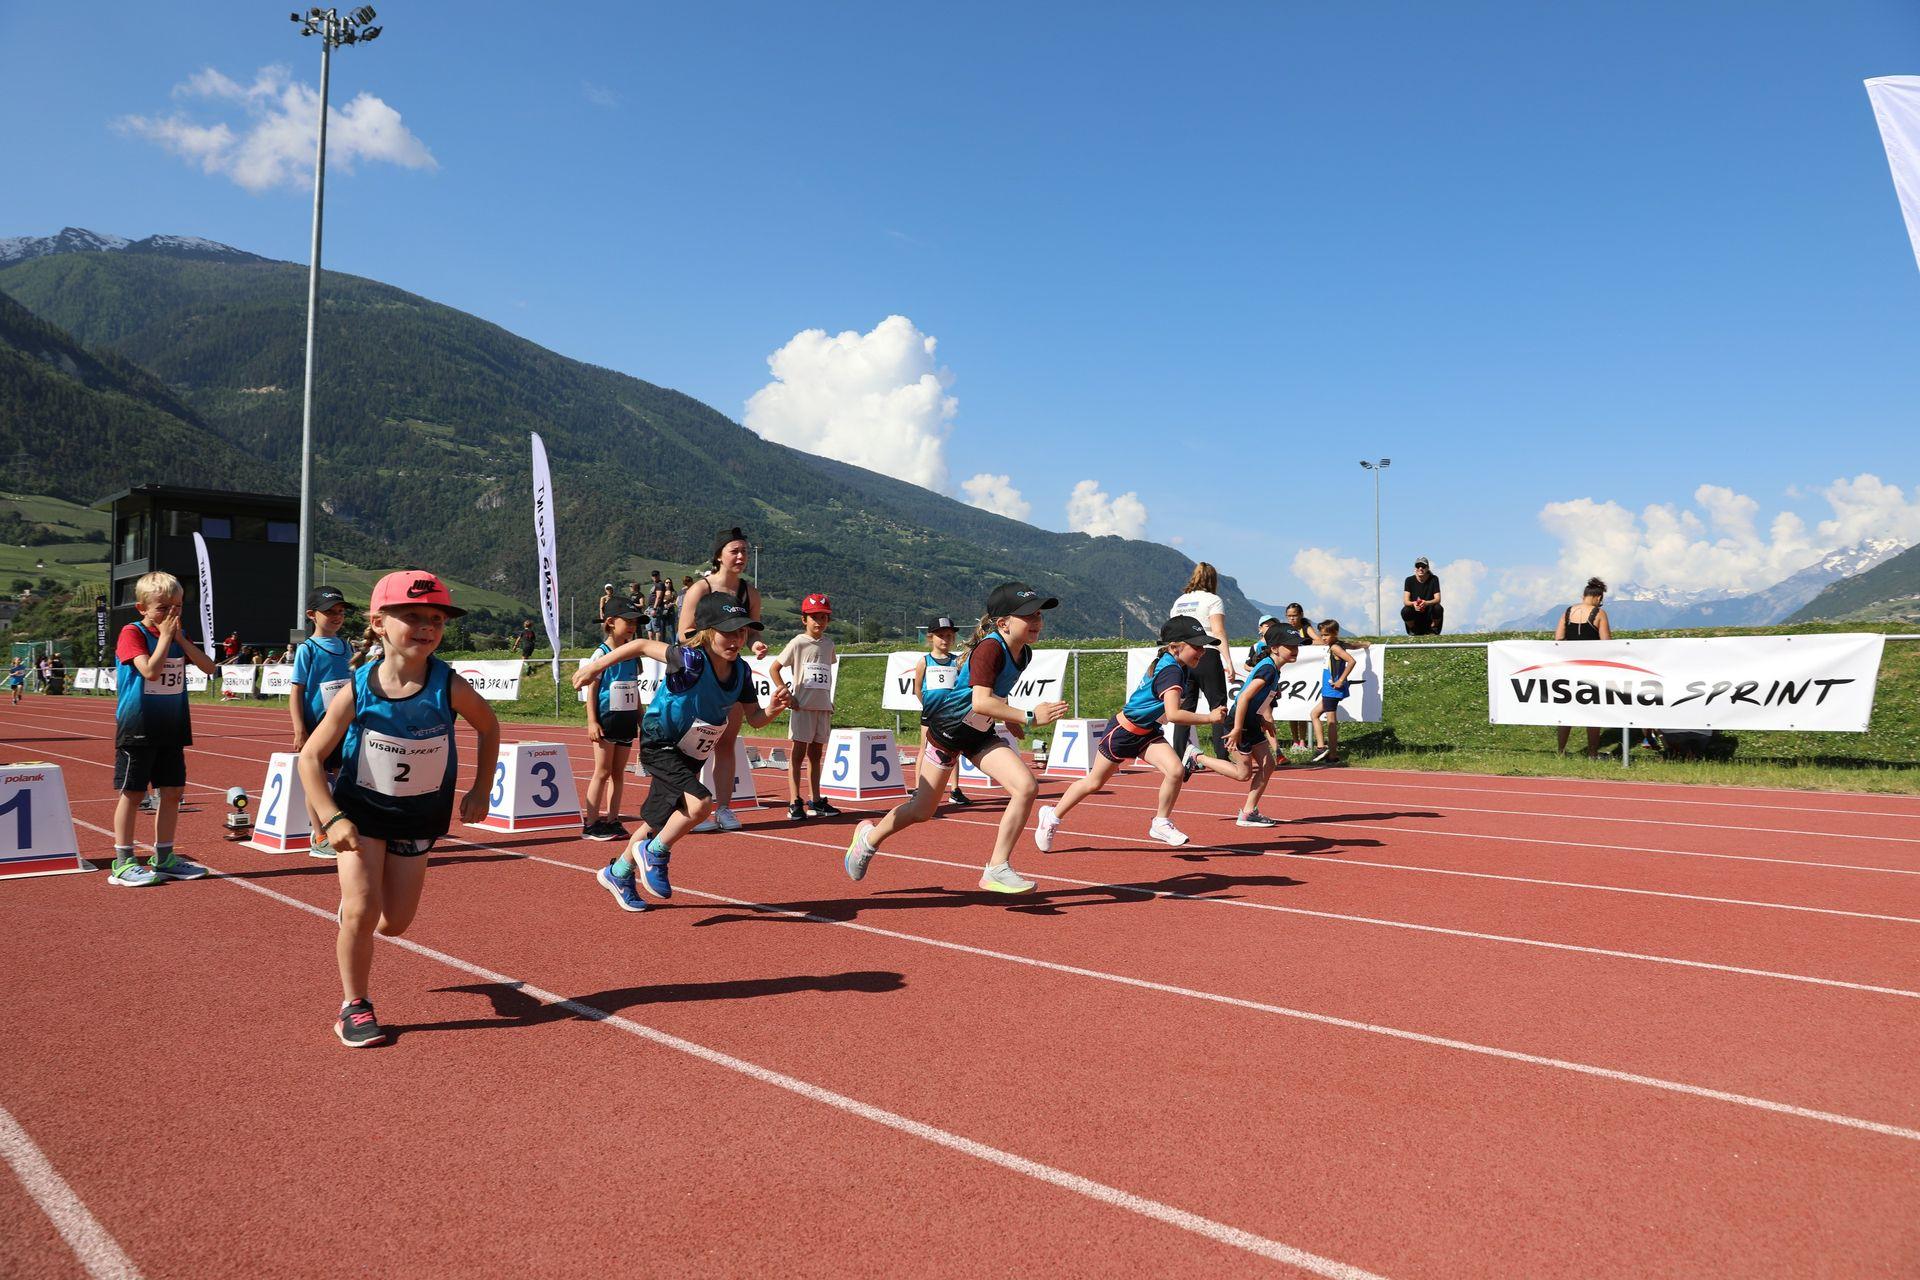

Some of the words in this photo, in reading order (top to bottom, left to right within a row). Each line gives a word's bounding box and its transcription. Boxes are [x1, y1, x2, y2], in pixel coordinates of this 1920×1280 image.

[413, 580, 436, 590] NIKE
[160, 672, 182, 687] 136
[486, 679, 518, 690] SPRINT
[938, 674, 945, 683] 8
[1009, 679, 1056, 697] INT
[625, 693, 634, 703] 11
[1670, 678, 1856, 707] SPRINT
[407, 746, 442, 755] SPRINT
[1062, 731, 1079, 763] 7
[394, 763, 411, 782] 2
[832, 744, 850, 782] 5
[871, 744, 890, 782] 5
[4, 773, 45, 784] polanik
[490, 761, 506, 808] 3
[531, 761, 559, 808] 3
[264, 773, 283, 825] 2
[0, 789, 32, 849] 1
